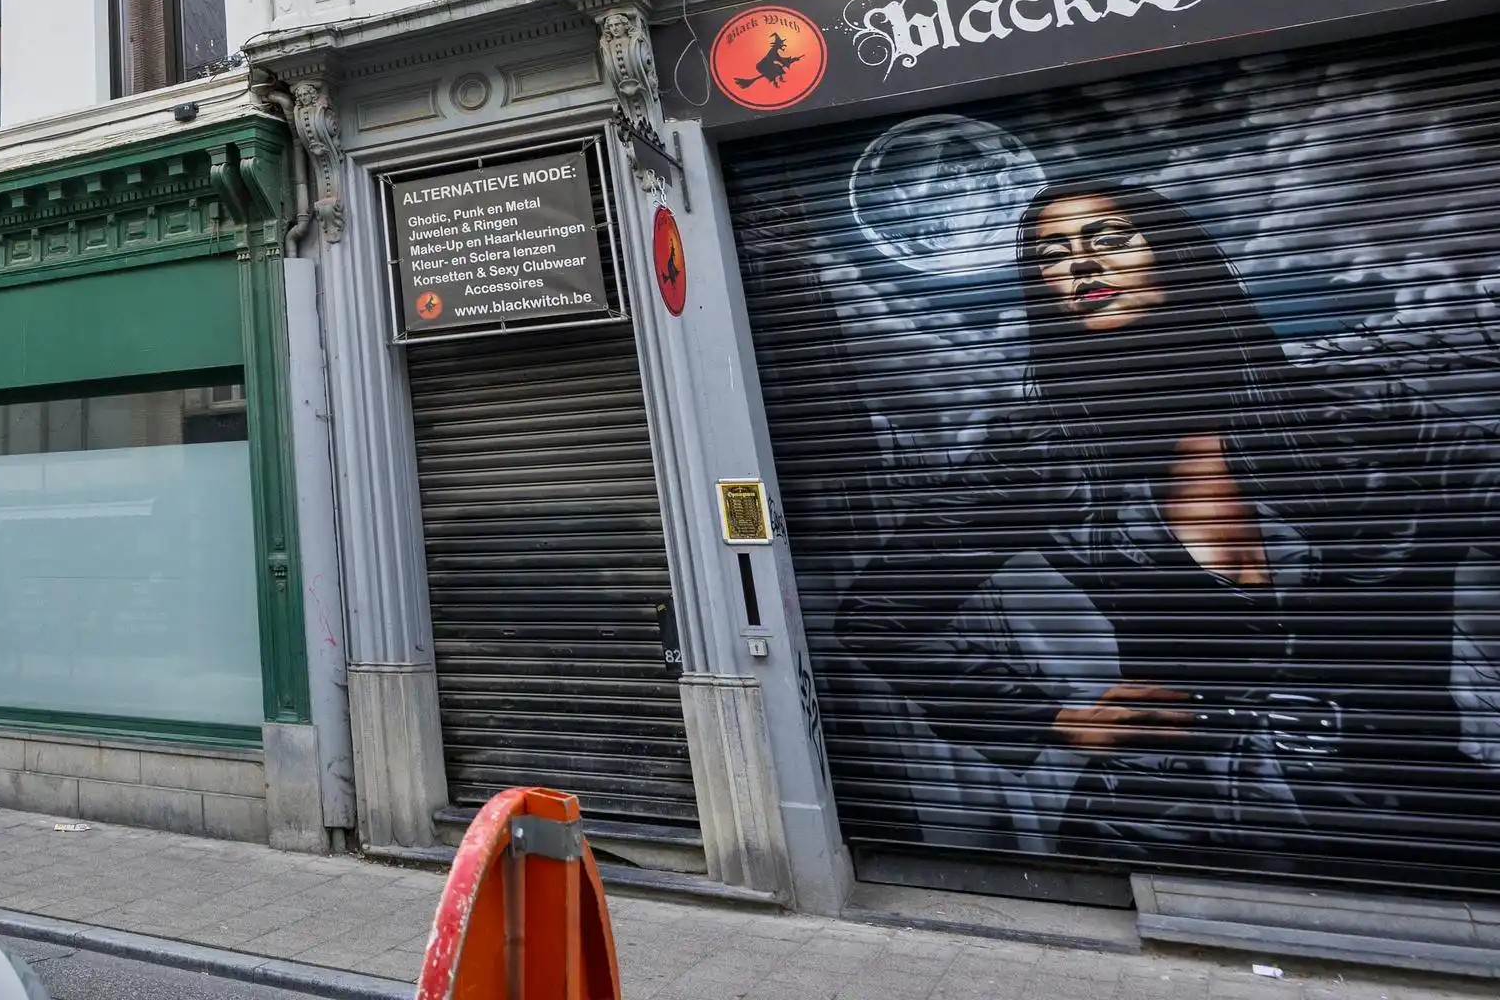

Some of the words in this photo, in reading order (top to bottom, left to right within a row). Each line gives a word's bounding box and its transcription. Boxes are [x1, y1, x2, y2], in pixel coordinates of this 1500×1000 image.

[726, 18, 758, 45] Black
[763, 14, 801, 33] Witch
[403, 174, 519, 205] ALTERNATIEVE
[522, 165, 577, 185] MODE:
[408, 213, 451, 228] Ghotic,
[453, 206, 484, 221] Punk
[487, 204, 503, 215] en
[506, 197, 541, 213] Metal
[408, 225, 459, 242] Juwelen
[461, 222, 472, 233] &
[474, 216, 518, 232] Ringen
[410, 240, 464, 257] Make-Up
[466, 238, 482, 248] en
[484, 222, 586, 246] Haarkleuringen
[411, 258, 449, 272] Kleur-
[451, 255, 467, 266] en
[469, 248, 511, 264] Sclera
[512, 243, 556, 258] lenzen
[413, 269, 474, 287] Korsetten
[476, 267, 487, 278] &
[489, 263, 520, 277] Sexy
[522, 255, 587, 273] Clubwear
[464, 277, 544, 296] Accessoires
[454, 291, 592, 317] www.blackwitch.be
[665, 649, 683, 663] 82
